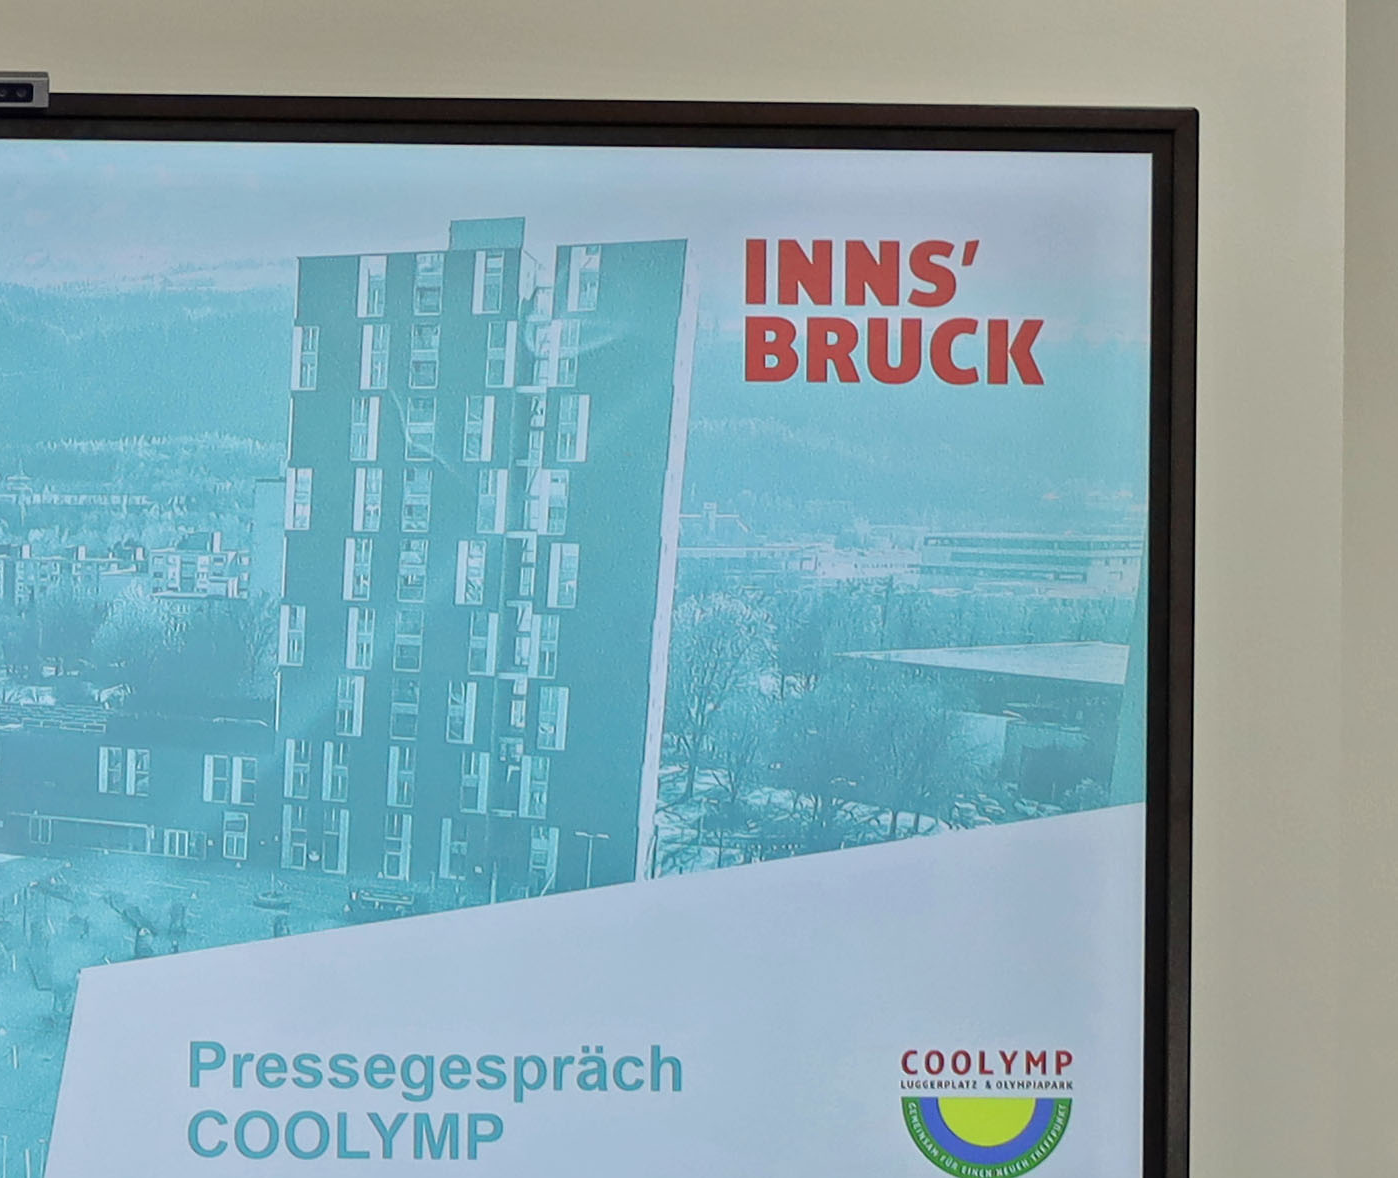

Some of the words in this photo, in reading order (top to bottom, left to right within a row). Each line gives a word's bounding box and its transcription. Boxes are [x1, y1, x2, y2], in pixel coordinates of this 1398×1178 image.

[744, 238, 980, 308] INNS'
[744, 315, 1045, 386] BRUCK
[188, 1040, 683, 1104] Pressegespräch
[901, 1050, 1073, 1076] COOLYMP
[901, 1080, 978, 1090] LUGGERPLATZ
[985, 1080, 992, 1089] &
[996, 1080, 1074, 1091] OLYMPIAPARK
[187, 1109, 505, 1161] COOLYMP
